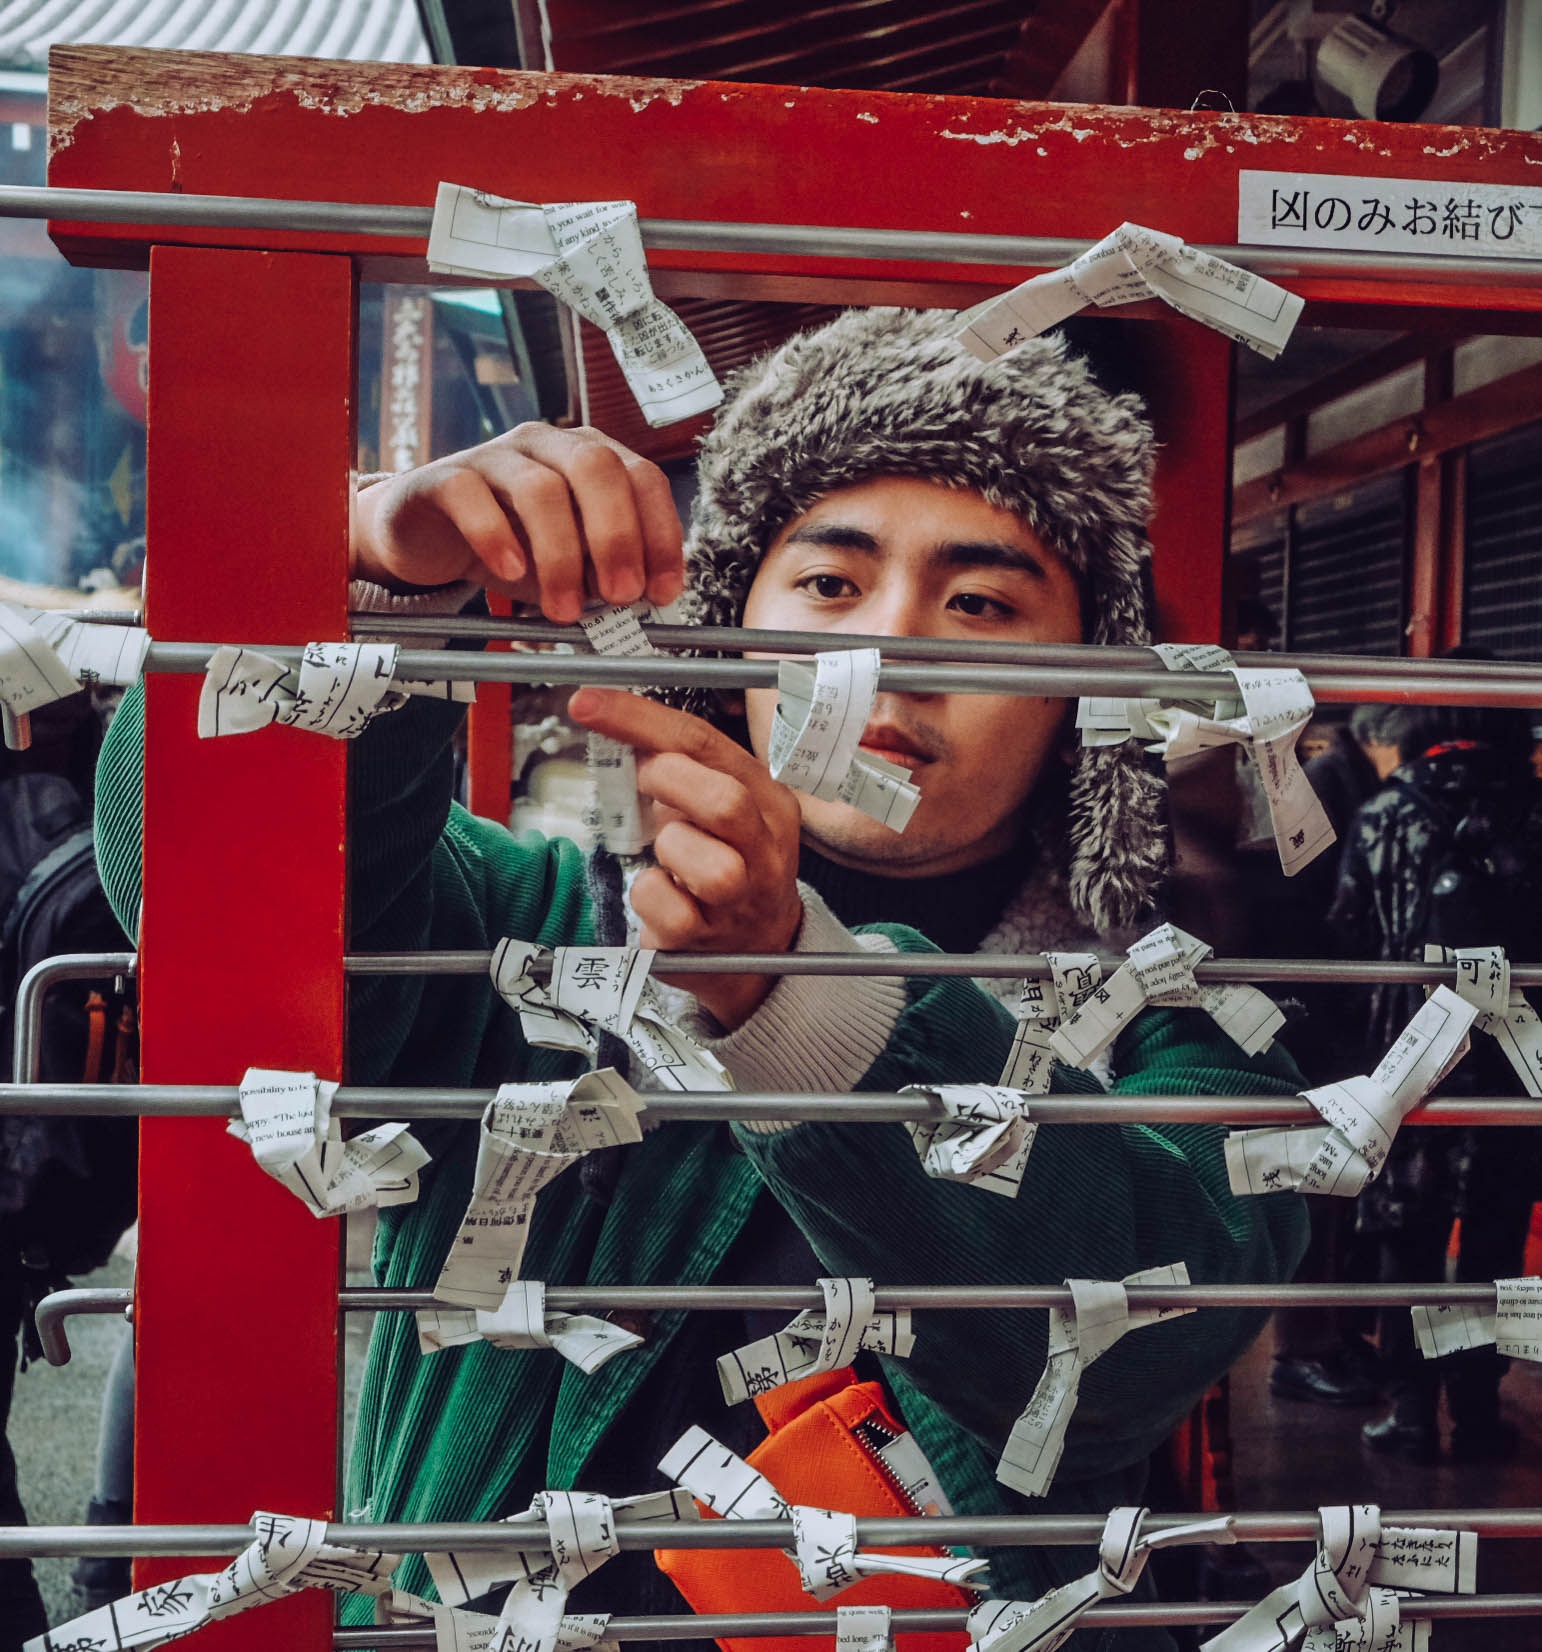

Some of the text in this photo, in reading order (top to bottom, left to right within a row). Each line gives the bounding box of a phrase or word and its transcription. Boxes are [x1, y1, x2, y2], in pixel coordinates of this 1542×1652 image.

[1271, 189, 1542, 240] 凶のみお結び
[571, 957, 610, 990] 雲
[1456, 958, 1486, 985] 可
[276, 1126, 303, 1139] house
